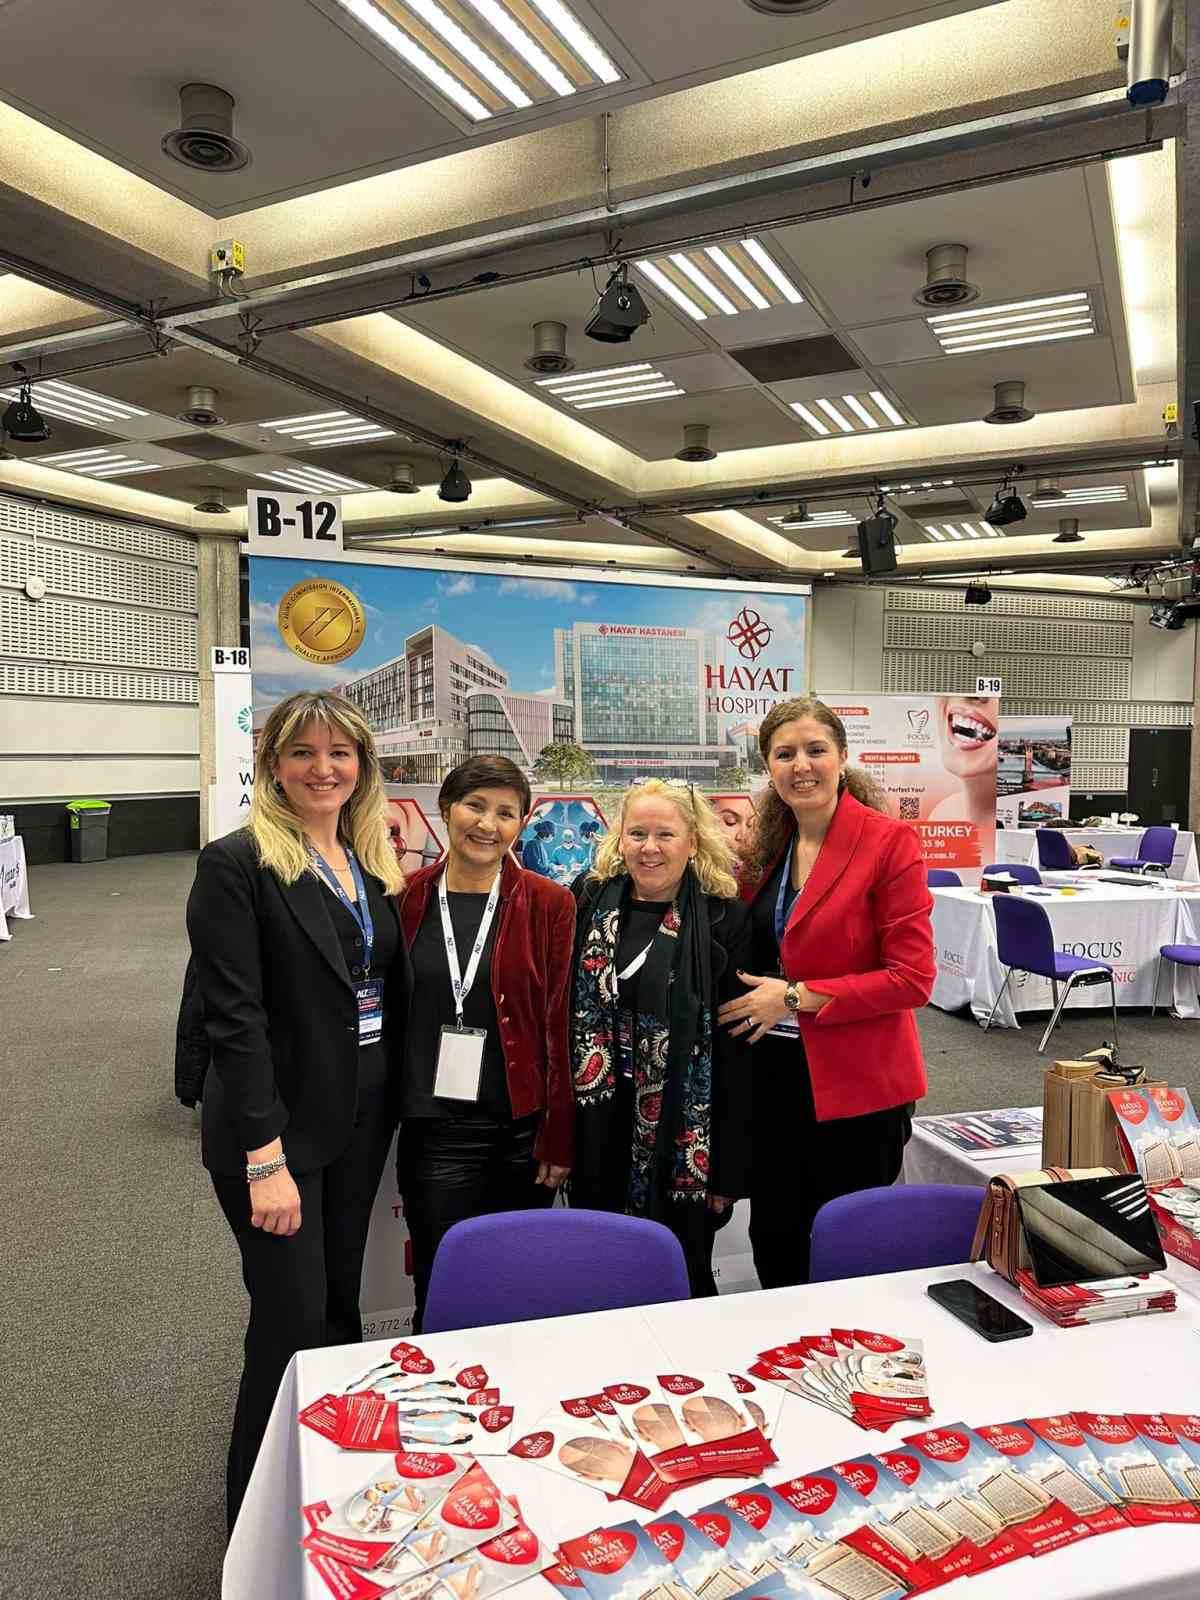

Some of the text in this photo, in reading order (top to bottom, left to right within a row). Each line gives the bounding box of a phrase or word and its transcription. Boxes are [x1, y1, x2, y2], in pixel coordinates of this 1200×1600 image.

[257, 496, 336, 541] B-12
[215, 650, 247, 665] B-18
[704, 664, 794, 692] HAYAT
[978, 679, 1000, 691] B-19
[708, 696, 785, 715] HOSPIT
[920, 826, 972, 837] TURKEY
[1062, 942, 1122, 959] FOCUS
[380, 1319, 399, 1330] 772
[1089, 1423, 1129, 1434] HAYAT
[923, 1435, 960, 1452] HAYAT
[989, 1432, 1024, 1445] HAYAT
[406, 1453, 442, 1470] HAYAT
[788, 1483, 826, 1504] HAYAT
[458, 1496, 488, 1523] HAYAT
[502, 1535, 527, 1558] AYAT
[582, 1538, 625, 1561] HAYAT
